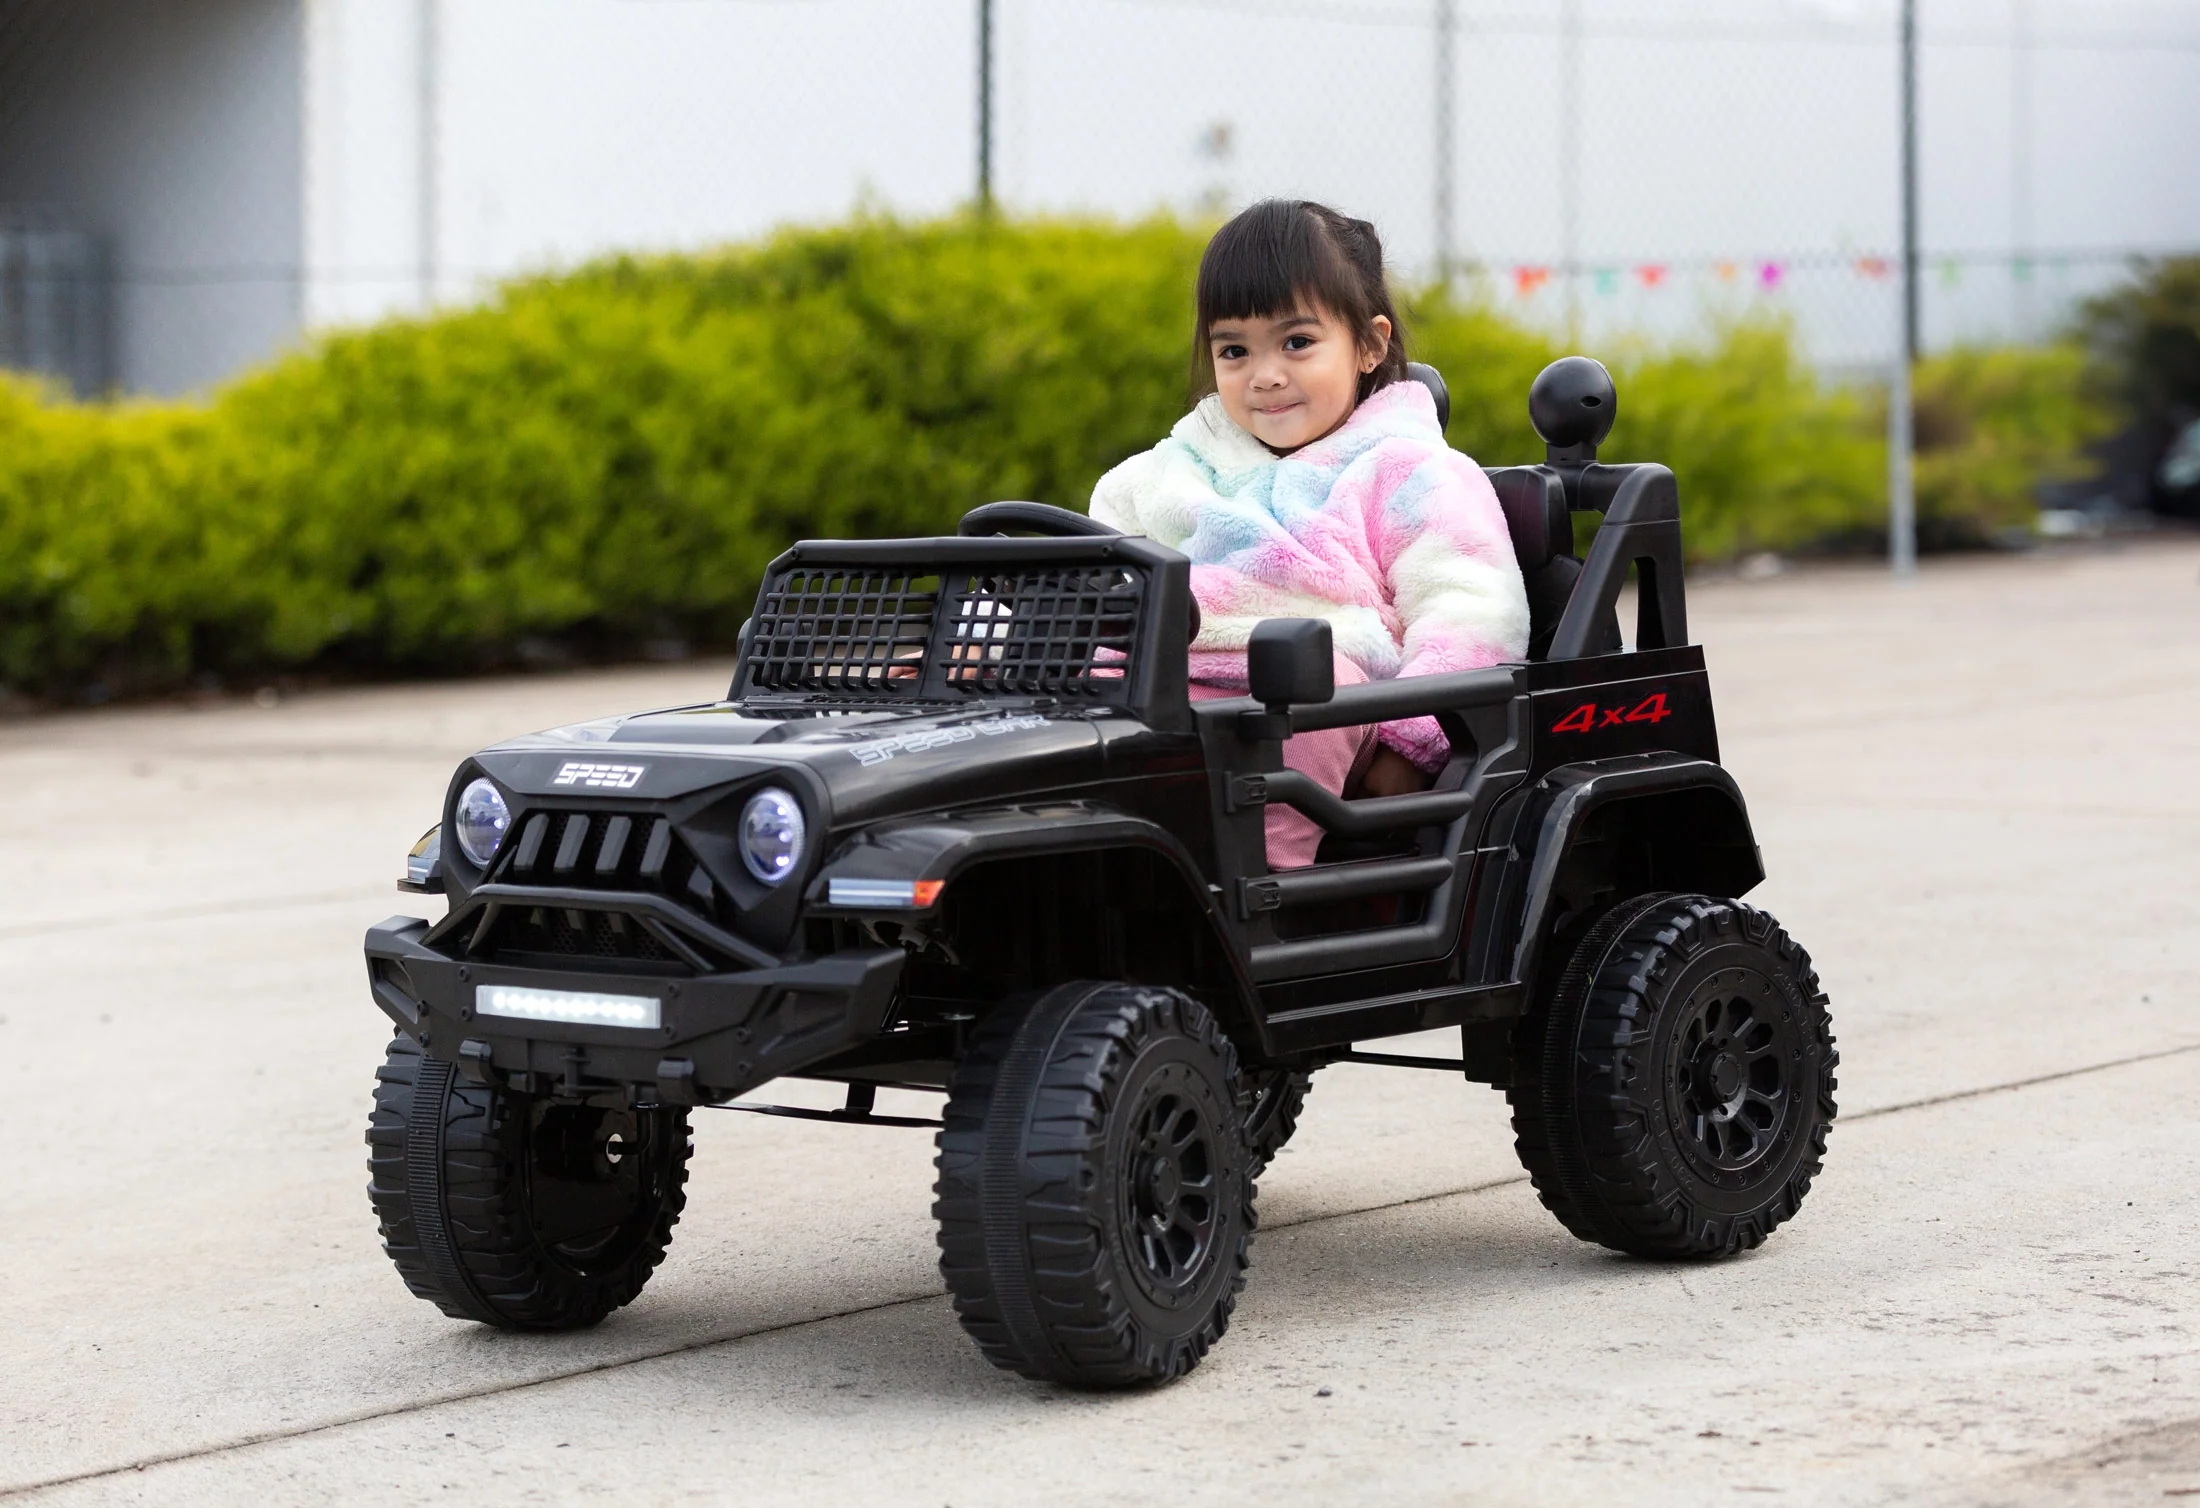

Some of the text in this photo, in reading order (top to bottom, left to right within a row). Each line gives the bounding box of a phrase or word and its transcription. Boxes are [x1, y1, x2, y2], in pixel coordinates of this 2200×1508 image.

[1551, 693, 1671, 733] 4x4
[849, 725, 976, 767] SPEED
[553, 762, 645, 788] SPEED
